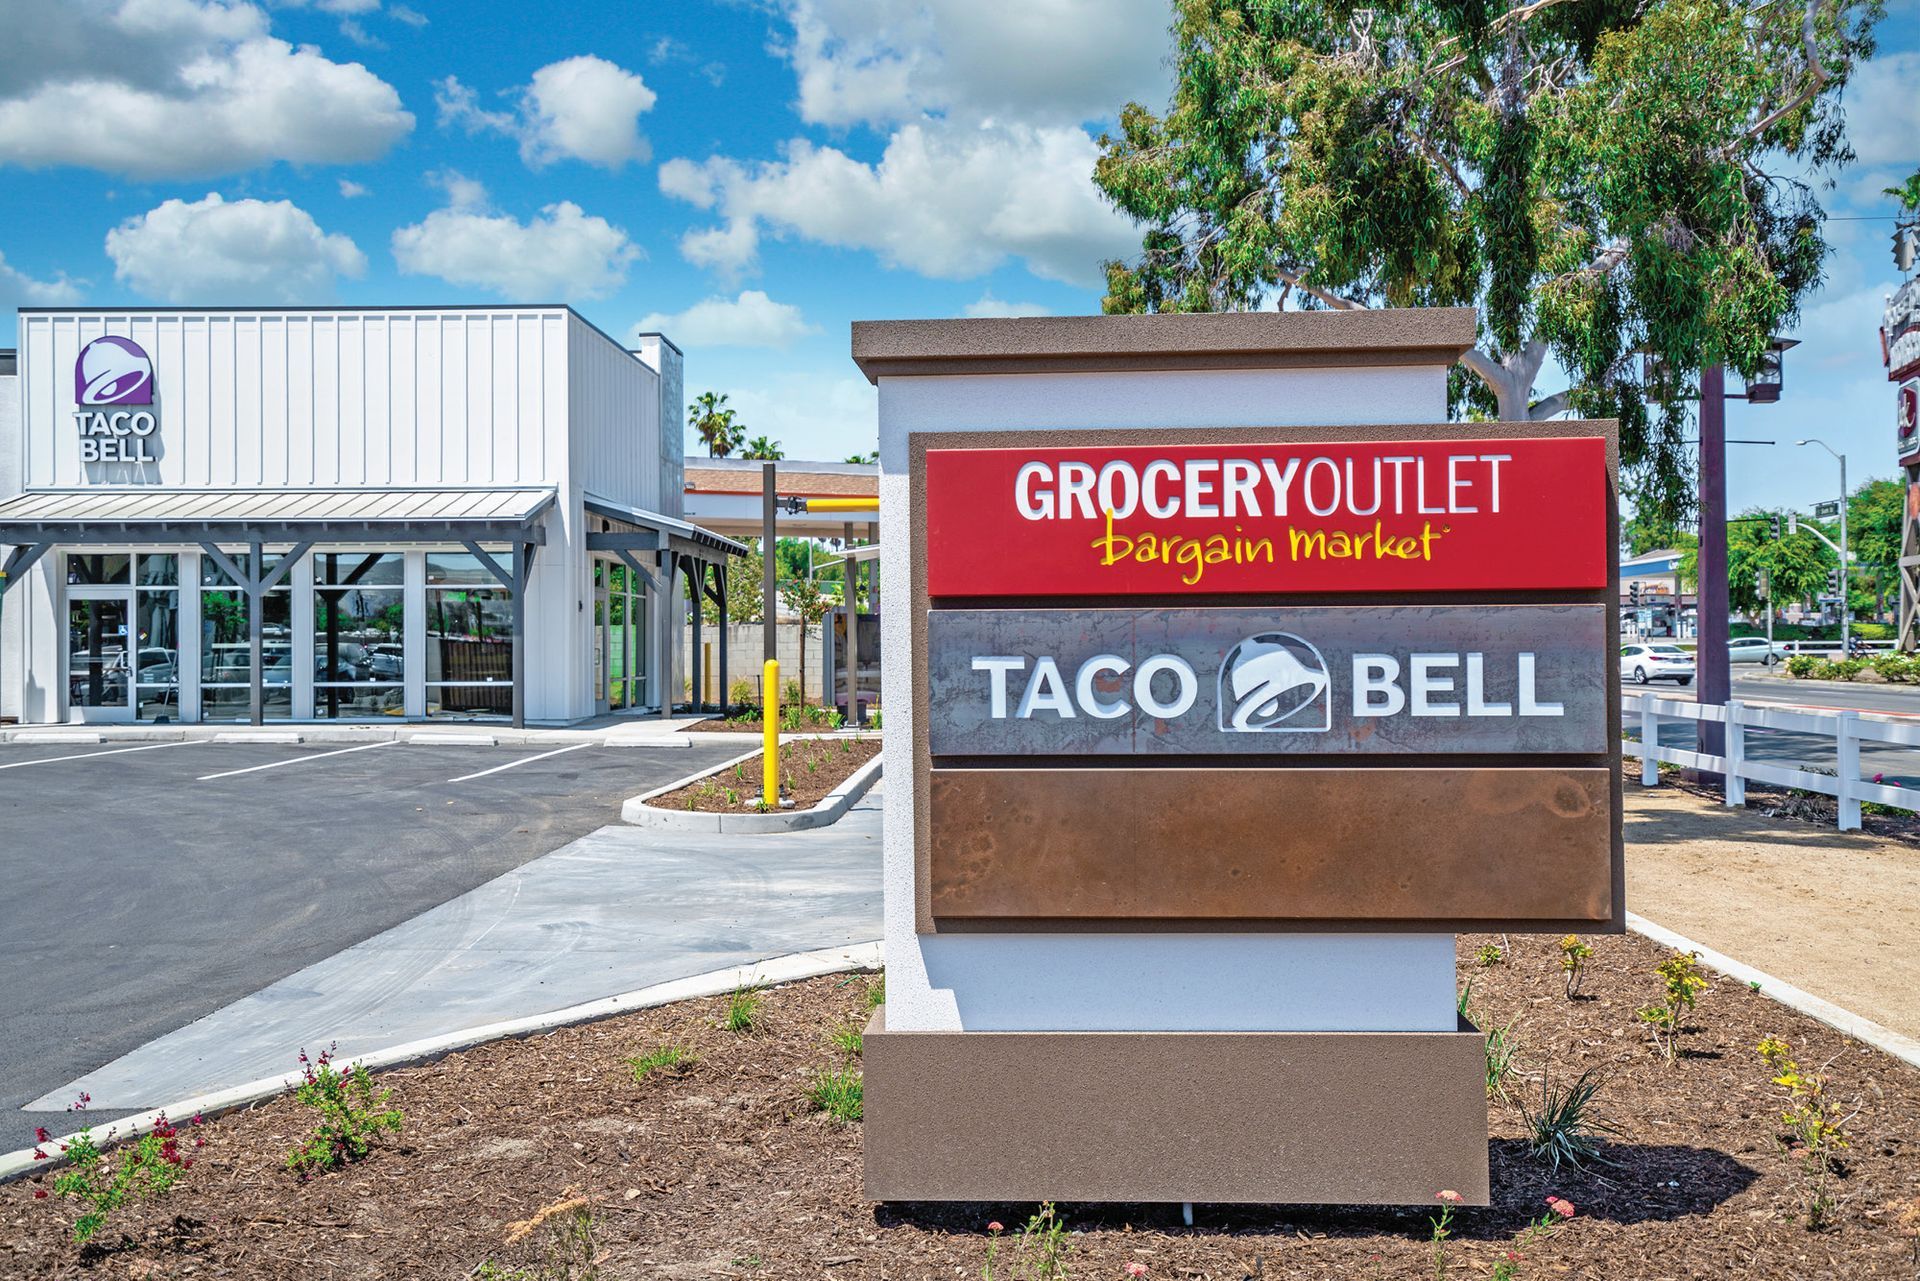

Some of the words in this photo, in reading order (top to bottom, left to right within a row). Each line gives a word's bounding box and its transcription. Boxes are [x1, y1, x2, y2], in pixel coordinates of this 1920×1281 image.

[72, 411, 156, 436] TACO
[80, 438, 154, 462] BELL
[1091, 508, 1274, 585] bargain
[1289, 518, 1442, 561] market
[972, 654, 1198, 719] TACO
[1352, 652, 1564, 717] BELL
